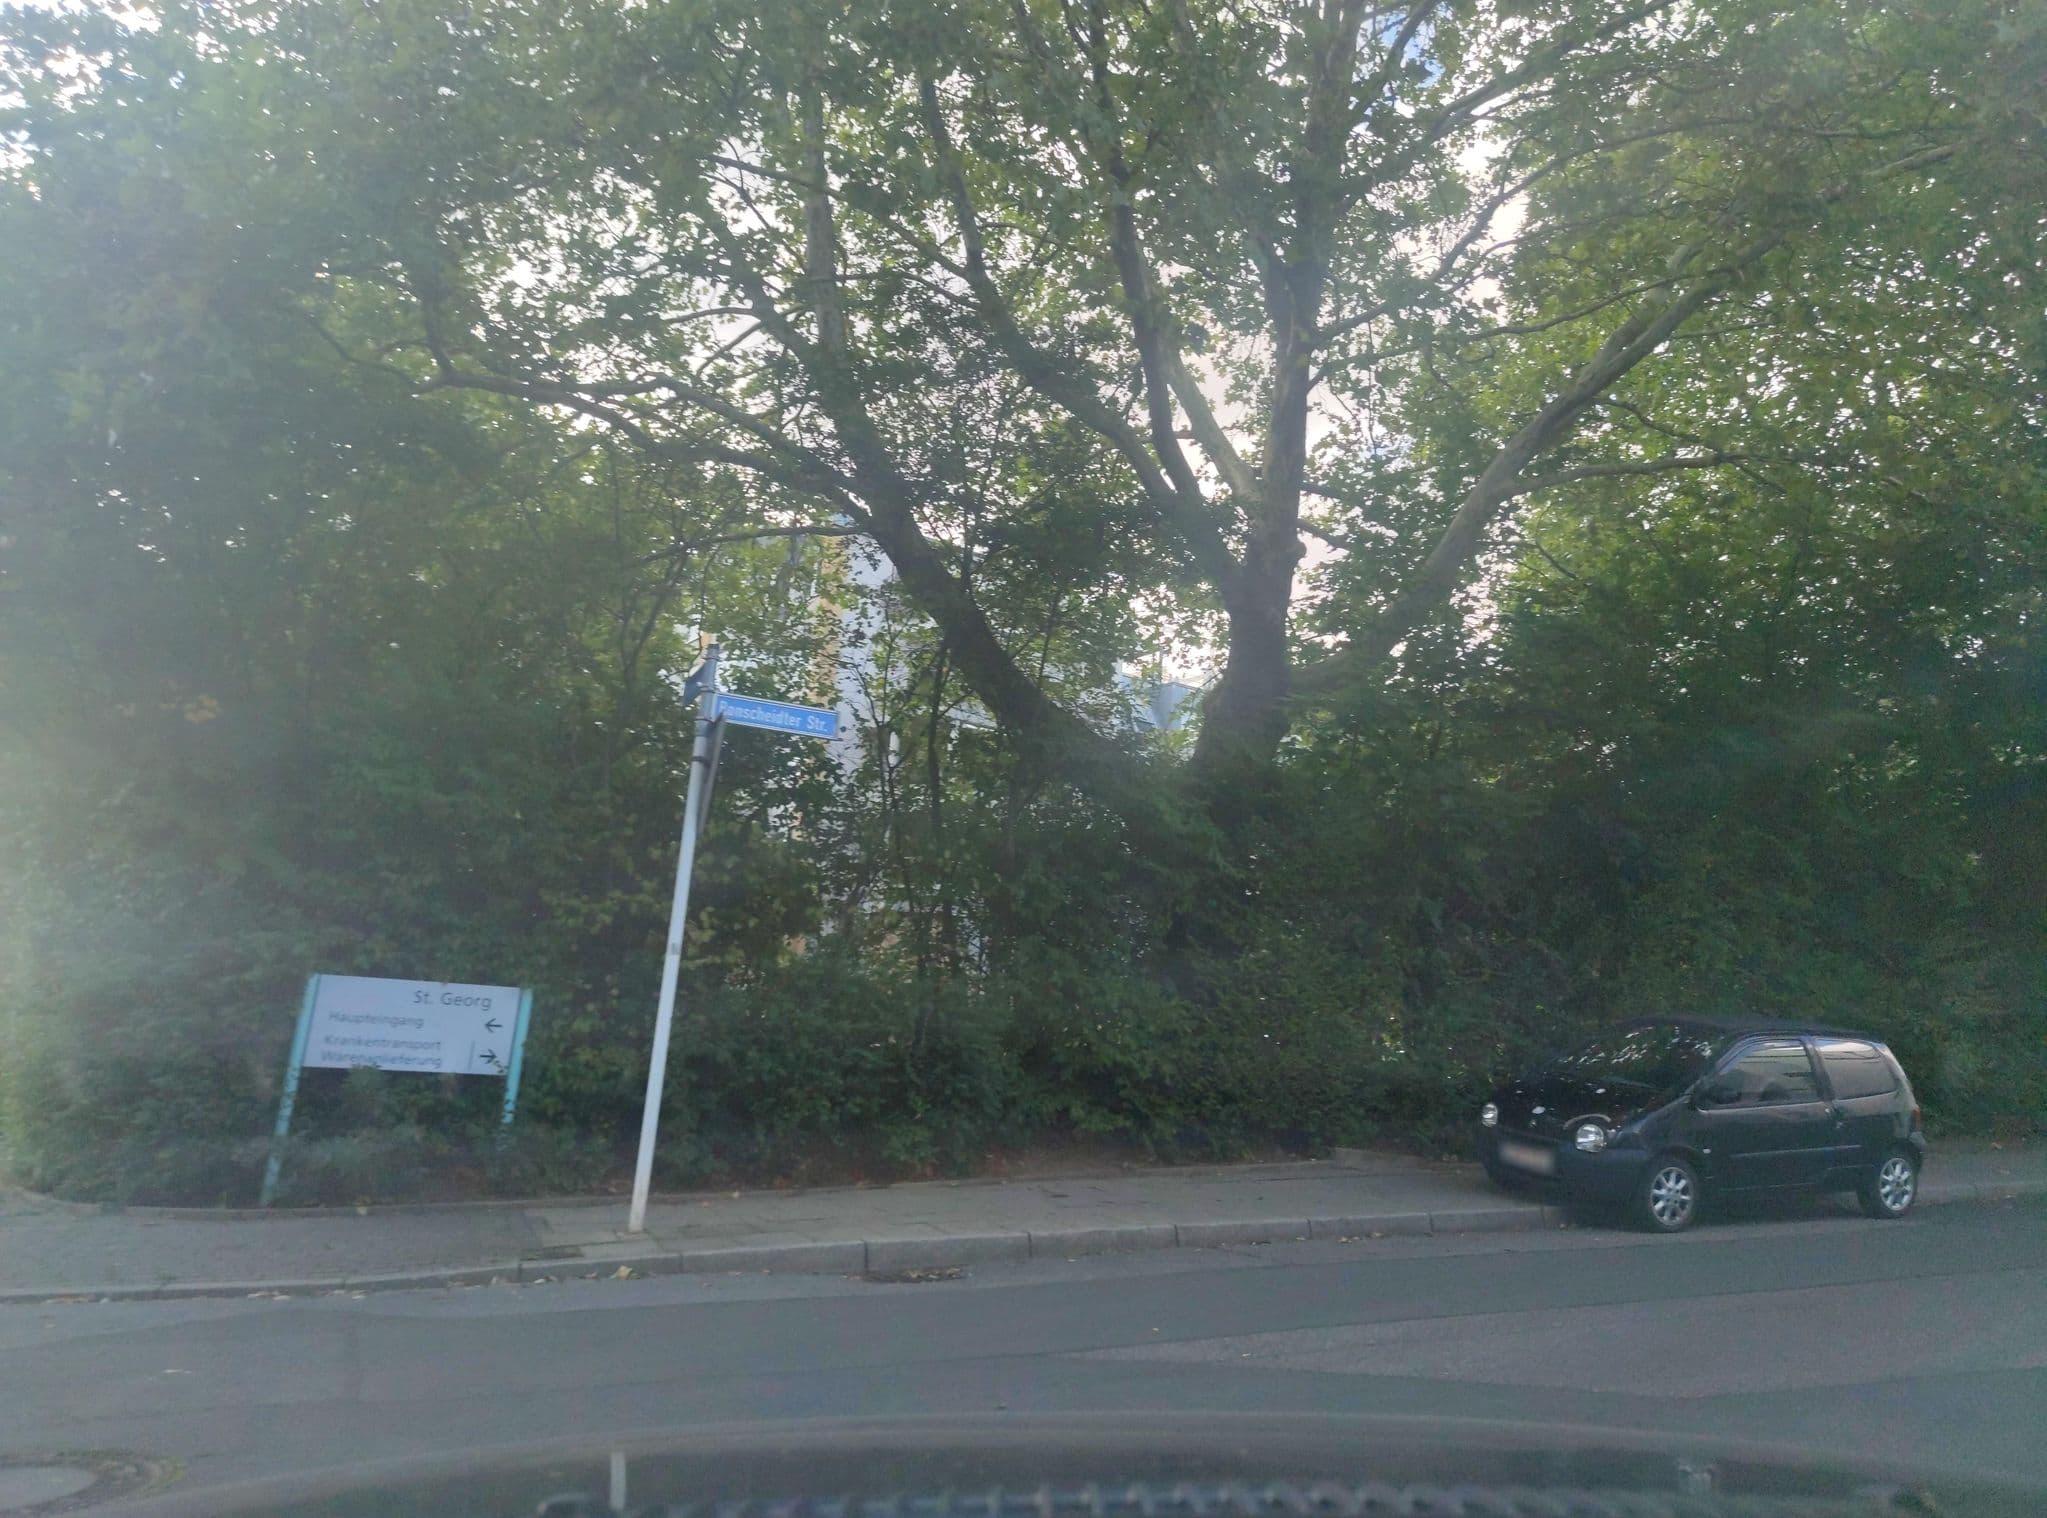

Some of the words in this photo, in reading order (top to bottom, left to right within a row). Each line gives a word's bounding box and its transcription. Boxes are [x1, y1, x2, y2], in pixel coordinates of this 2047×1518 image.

[806, 715, 828, 732] Str.
[413, 990, 435, 1005] St.
[440, 992, 492, 1011] Georg
[328, 1010, 425, 1029] Haupteingang
[324, 1034, 442, 1051] Krankentransport
